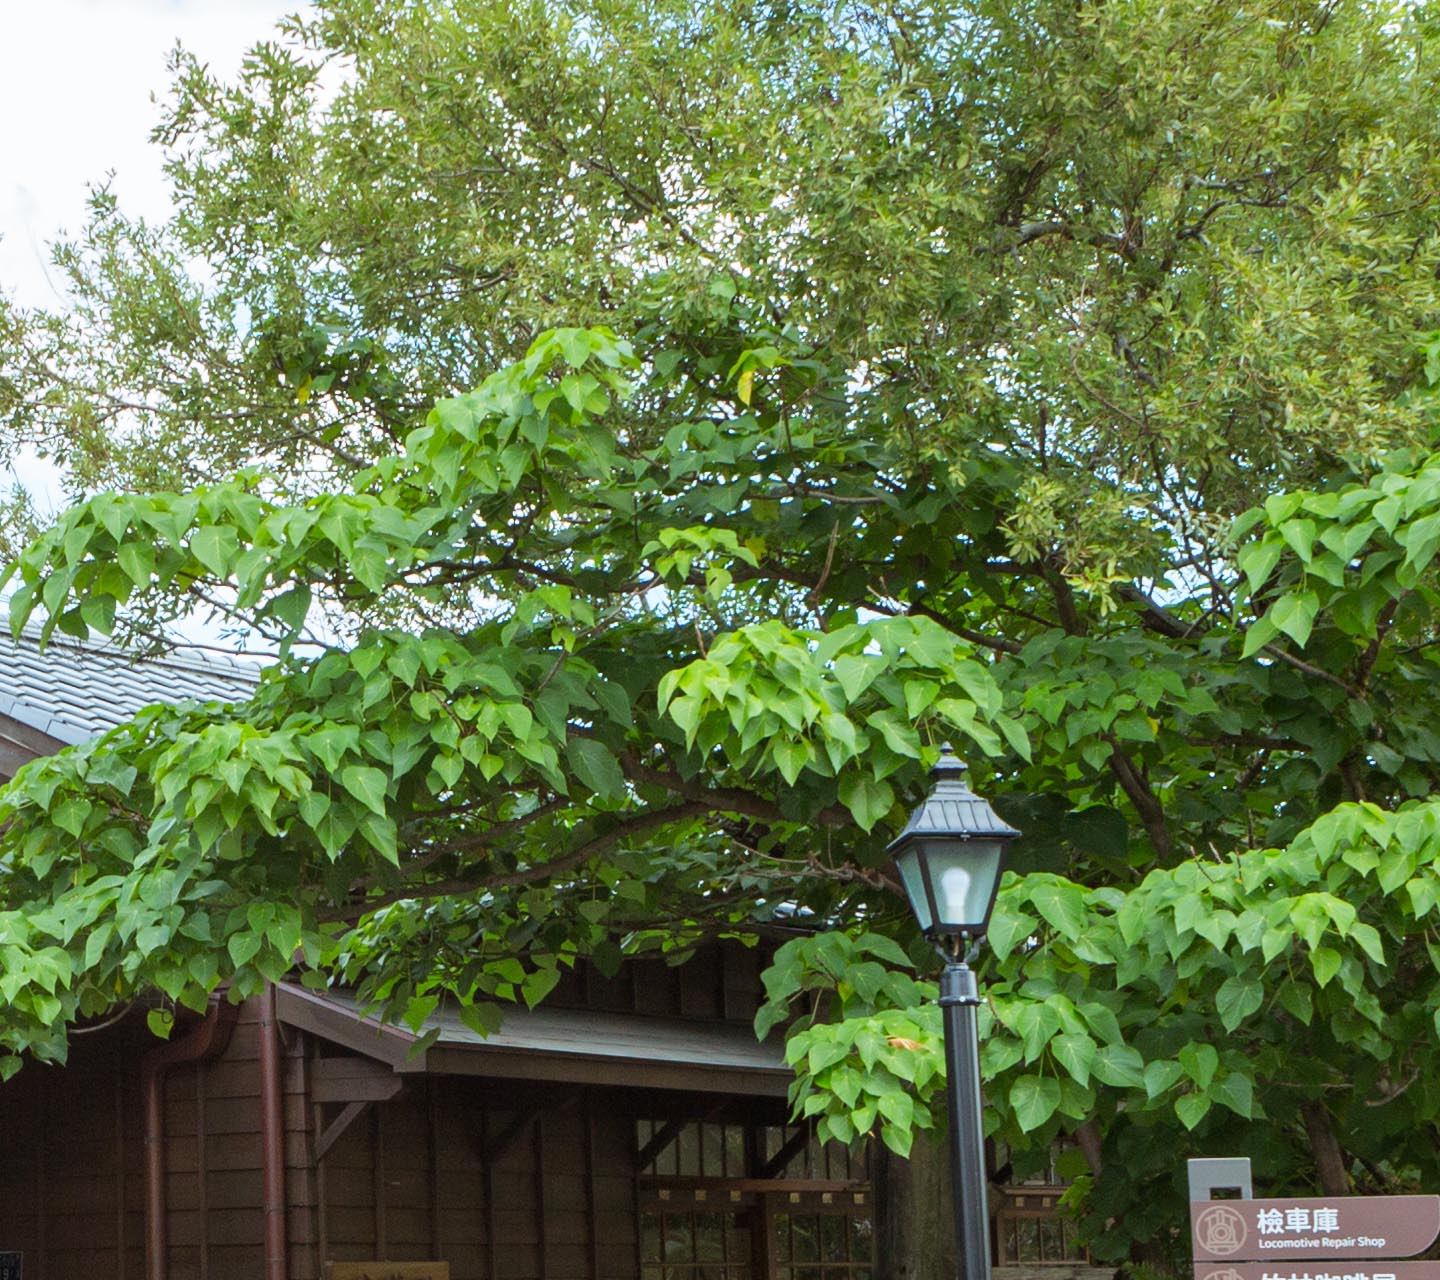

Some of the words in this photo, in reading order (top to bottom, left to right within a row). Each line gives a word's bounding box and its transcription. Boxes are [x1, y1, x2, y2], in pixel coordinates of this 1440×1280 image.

[1257, 1207, 1340, 1234] 檢車庫
[1259, 1237, 1320, 1249] Locomotive
[1321, 1236, 1356, 1249] Repair
[1357, 1236, 1386, 1248] Shop
